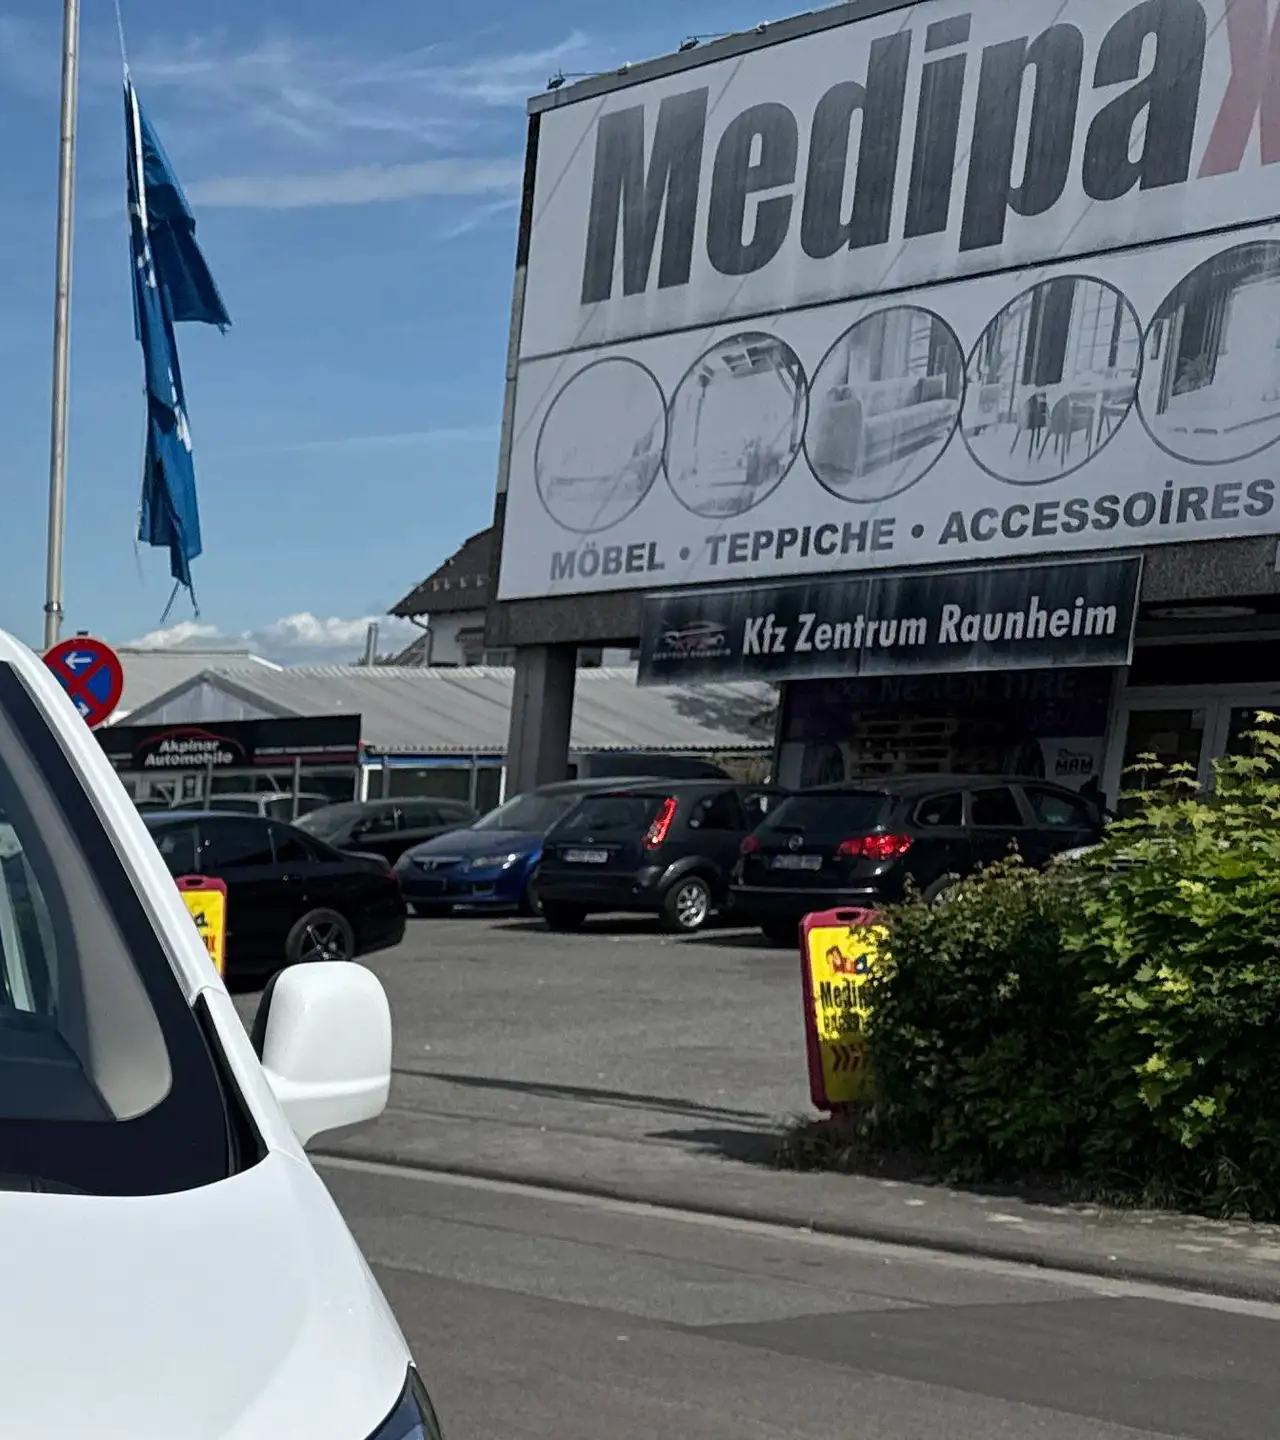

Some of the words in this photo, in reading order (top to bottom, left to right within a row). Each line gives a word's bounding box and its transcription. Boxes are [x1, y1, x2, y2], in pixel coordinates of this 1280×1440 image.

[549, 540, 666, 581] MÖBEL
[704, 517, 896, 567] TEPPICHE
[742, 612, 787, 656] Kfz
[795, 611, 927, 652] Zentrum
[938, 595, 1117, 645] Raunheim
